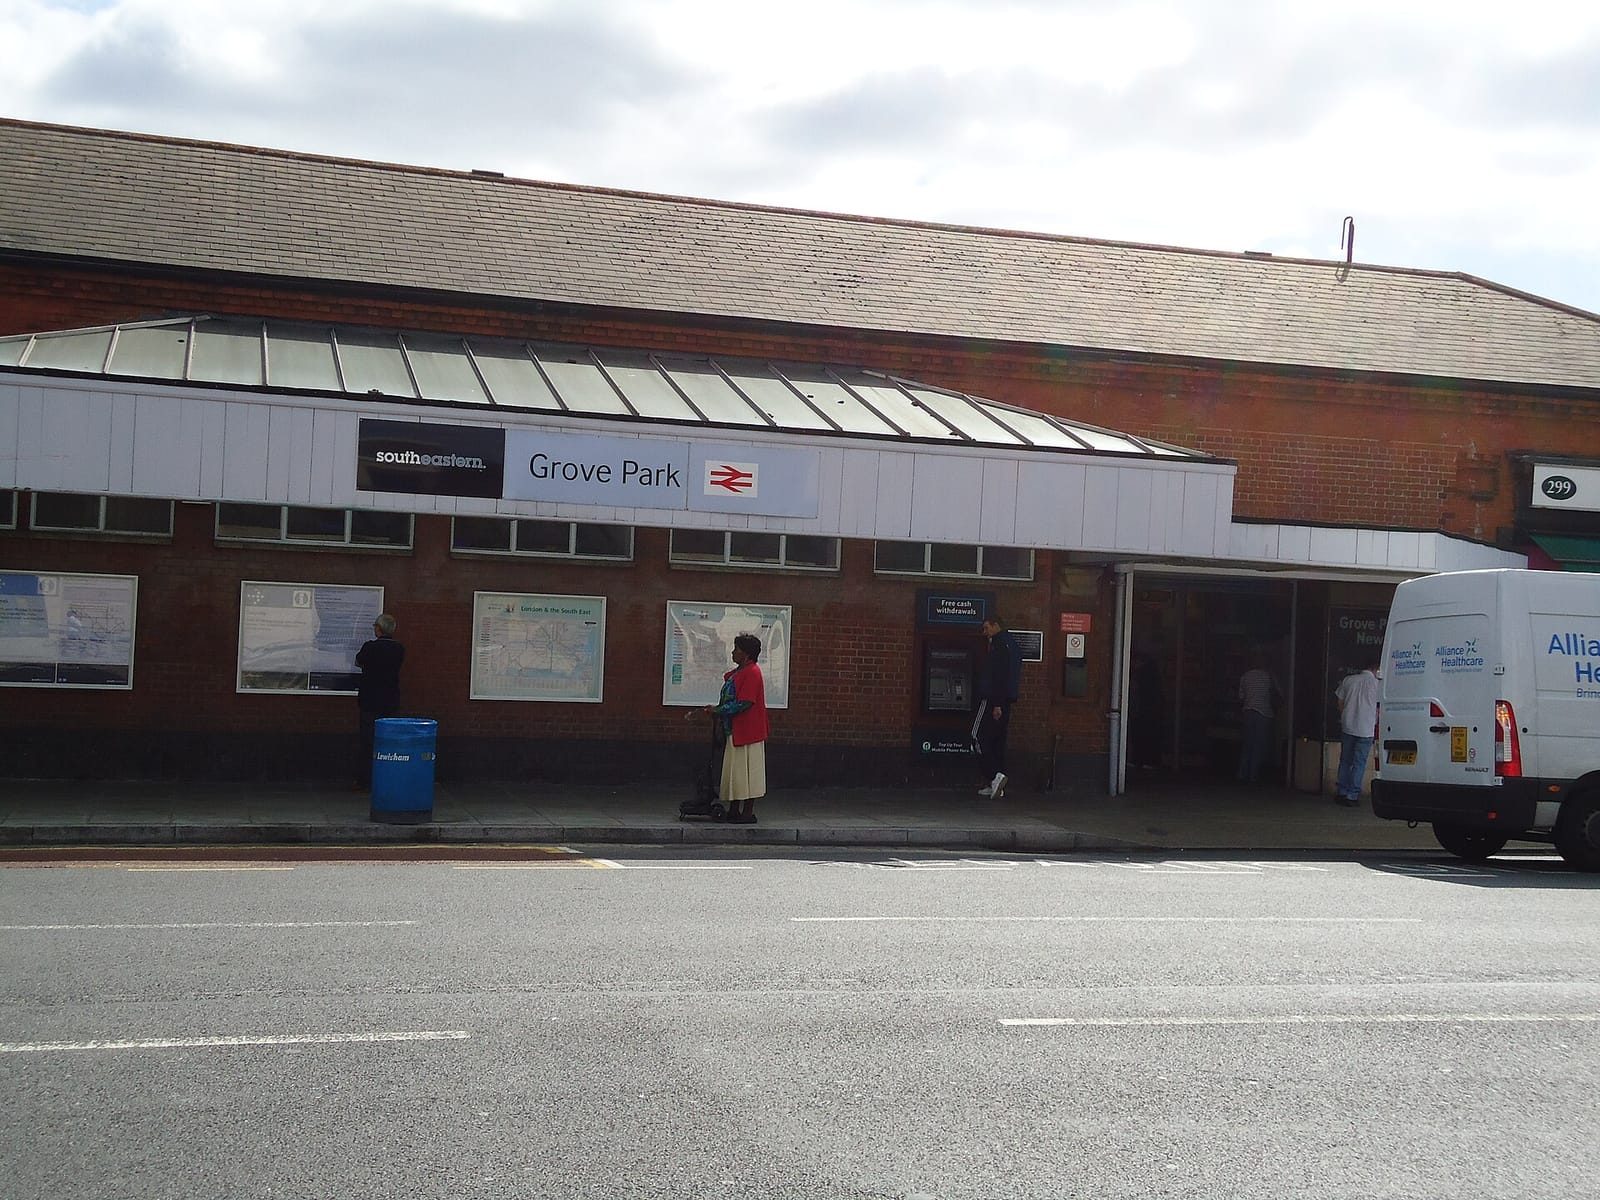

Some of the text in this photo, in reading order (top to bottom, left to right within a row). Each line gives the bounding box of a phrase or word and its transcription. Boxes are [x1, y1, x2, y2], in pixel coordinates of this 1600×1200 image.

[529, 453, 681, 488] Grove Park
[1546, 480, 1571, 494] 299
[941, 599, 955, 607] Free
[561, 607, 577, 615] South
[936, 607, 977, 615] withdrawals
[1339, 616, 1375, 630] Grove
[1392, 649, 1412, 659] Alliance
[1435, 645, 1465, 656] Alliance
[1395, 659, 1426, 669] Healthcare
[1441, 656, 1484, 667] Healthcare
[376, 752, 410, 762] Lewisham
